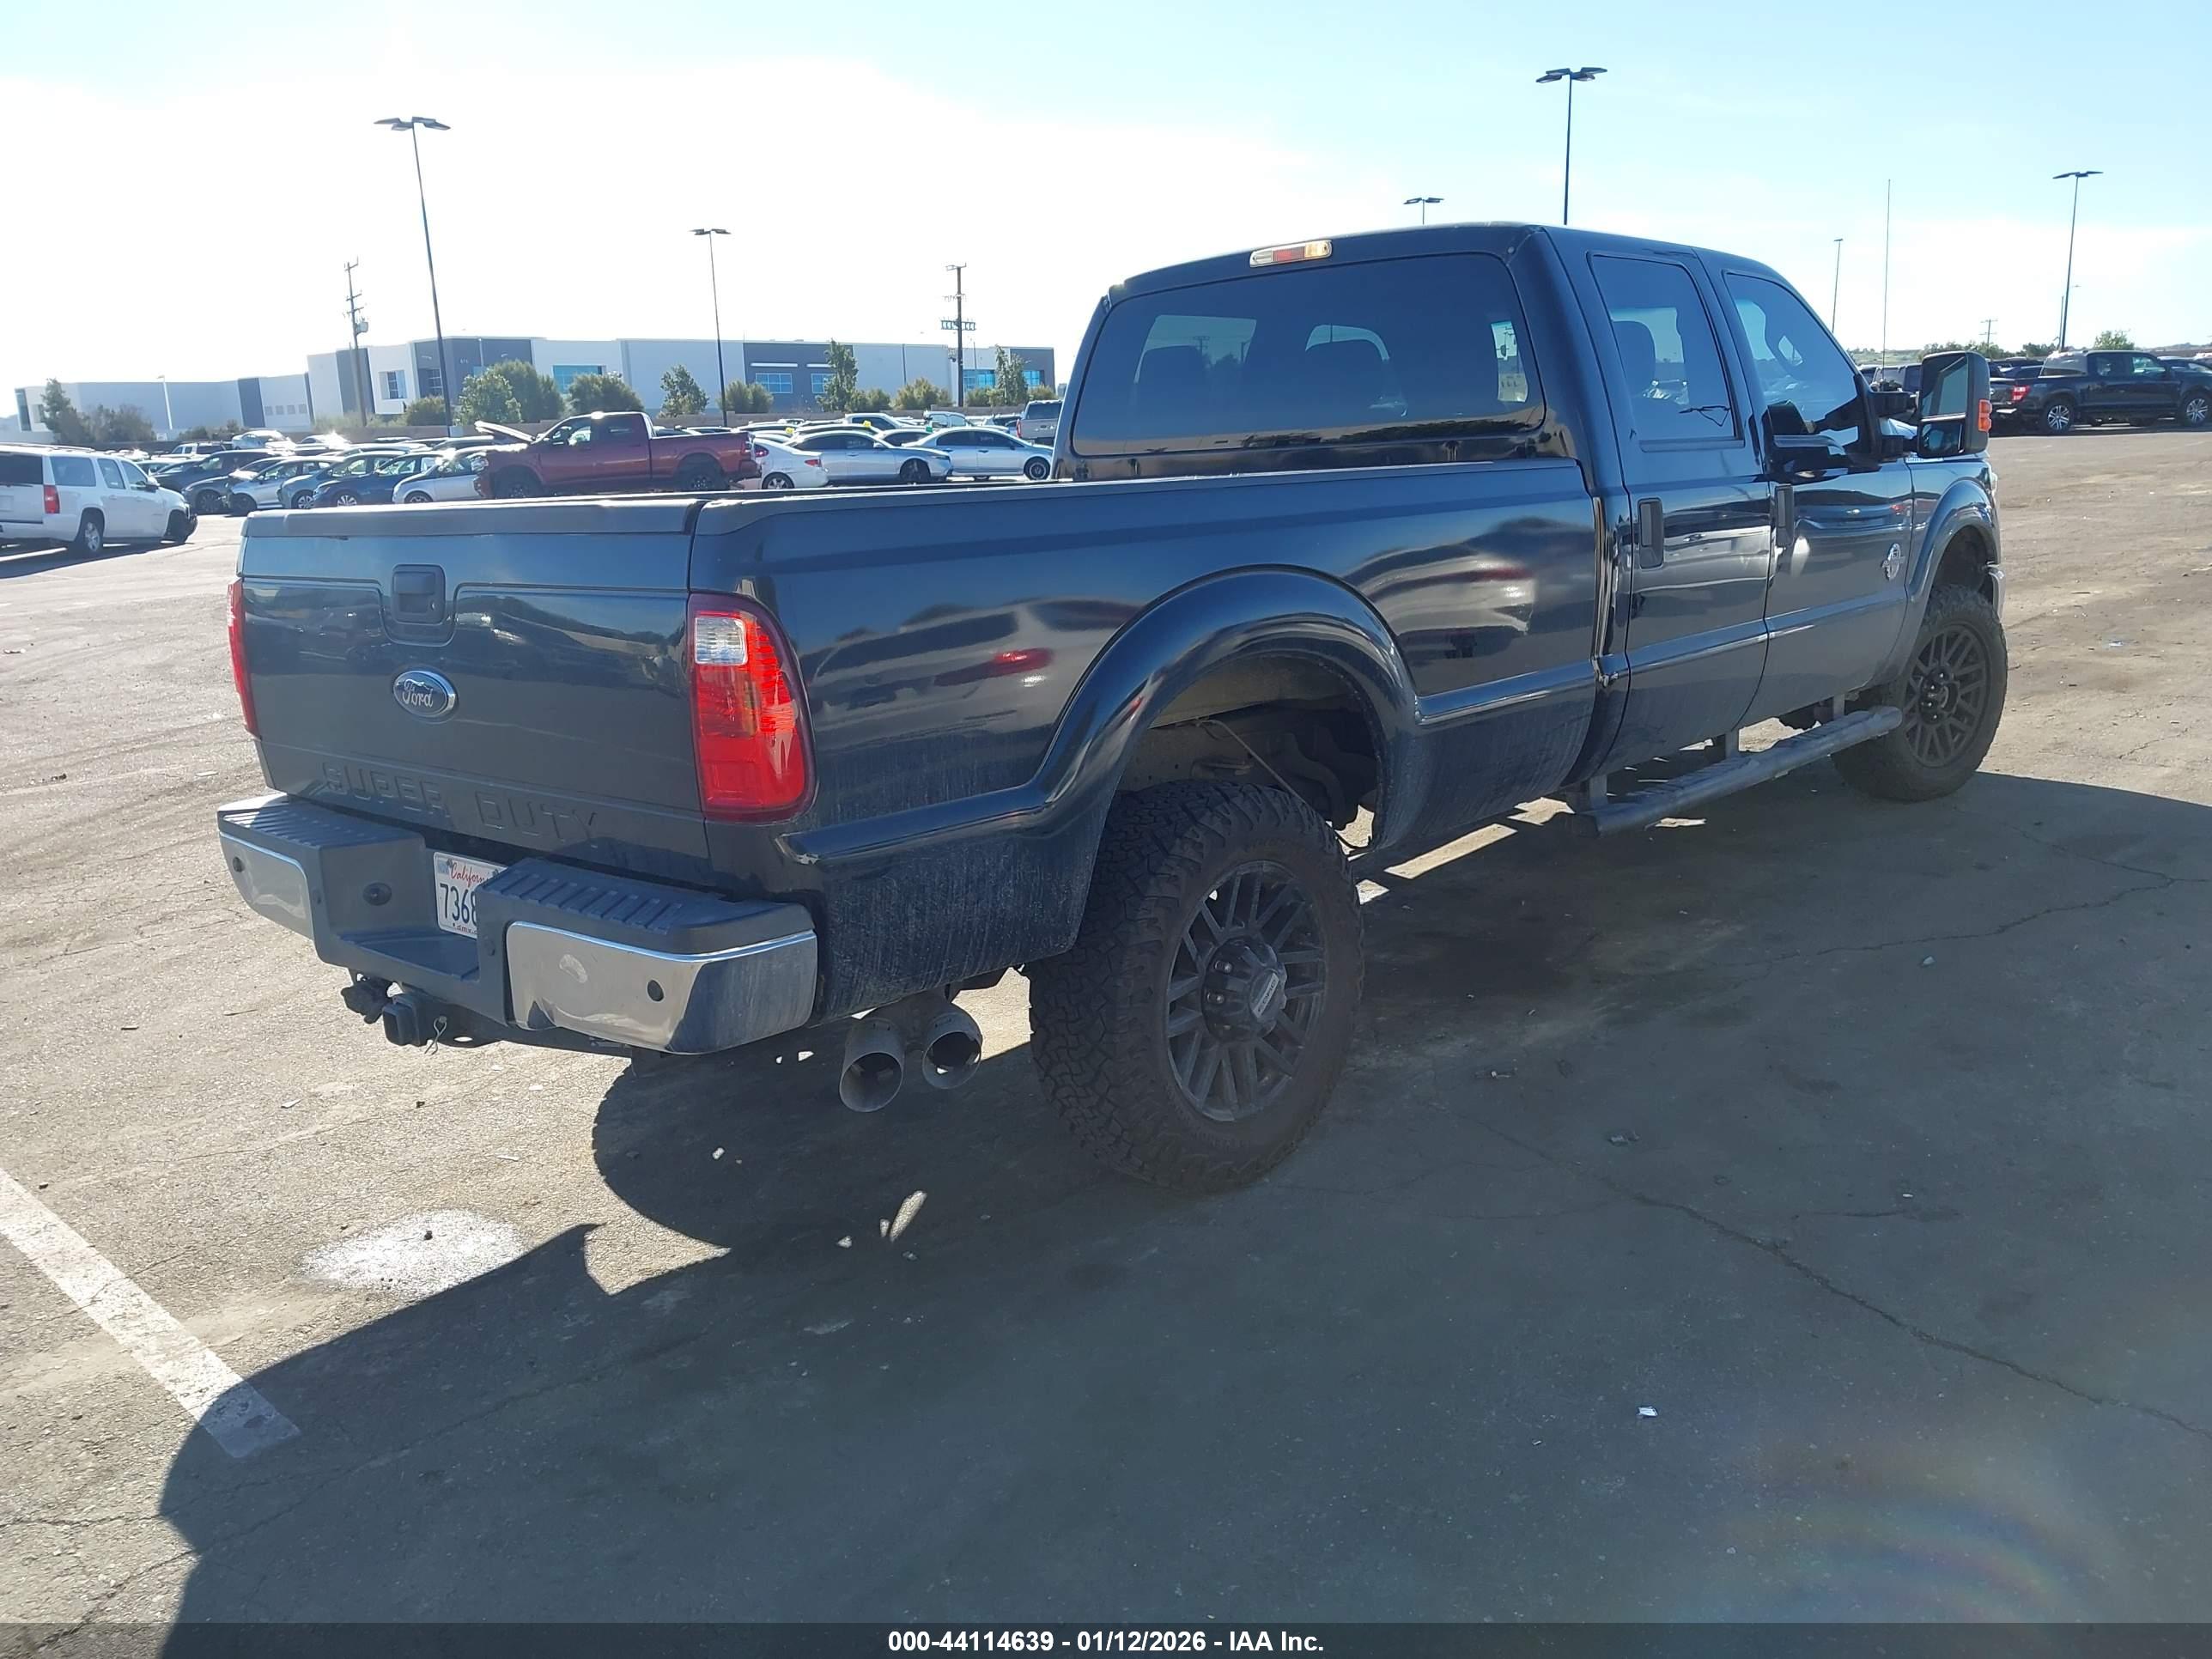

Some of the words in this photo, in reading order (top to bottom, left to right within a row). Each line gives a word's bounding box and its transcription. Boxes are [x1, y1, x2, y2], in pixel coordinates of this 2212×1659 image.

[402, 678, 434, 708] Ford
[323, 761, 457, 830] SUPER
[474, 789, 599, 846] DUTY
